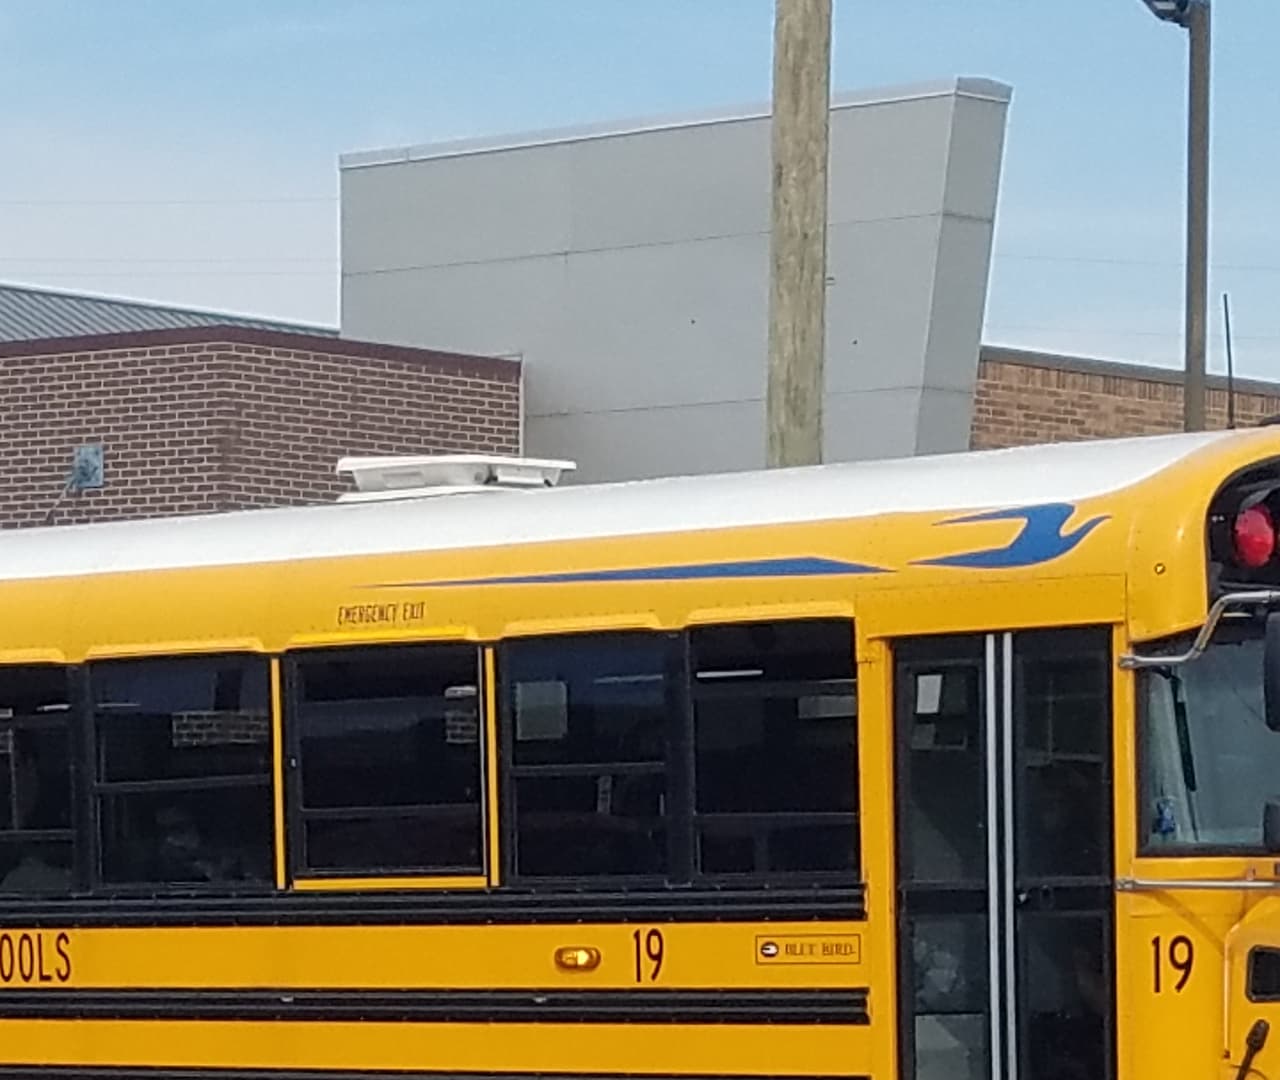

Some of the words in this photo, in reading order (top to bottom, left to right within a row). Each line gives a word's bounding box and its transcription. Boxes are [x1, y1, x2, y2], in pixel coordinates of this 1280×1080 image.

[337, 603, 396, 625] EMERGENCY
[402, 601, 425, 621] EXIT
[633, 928, 664, 983] 19
[1151, 935, 1194, 993] 19
